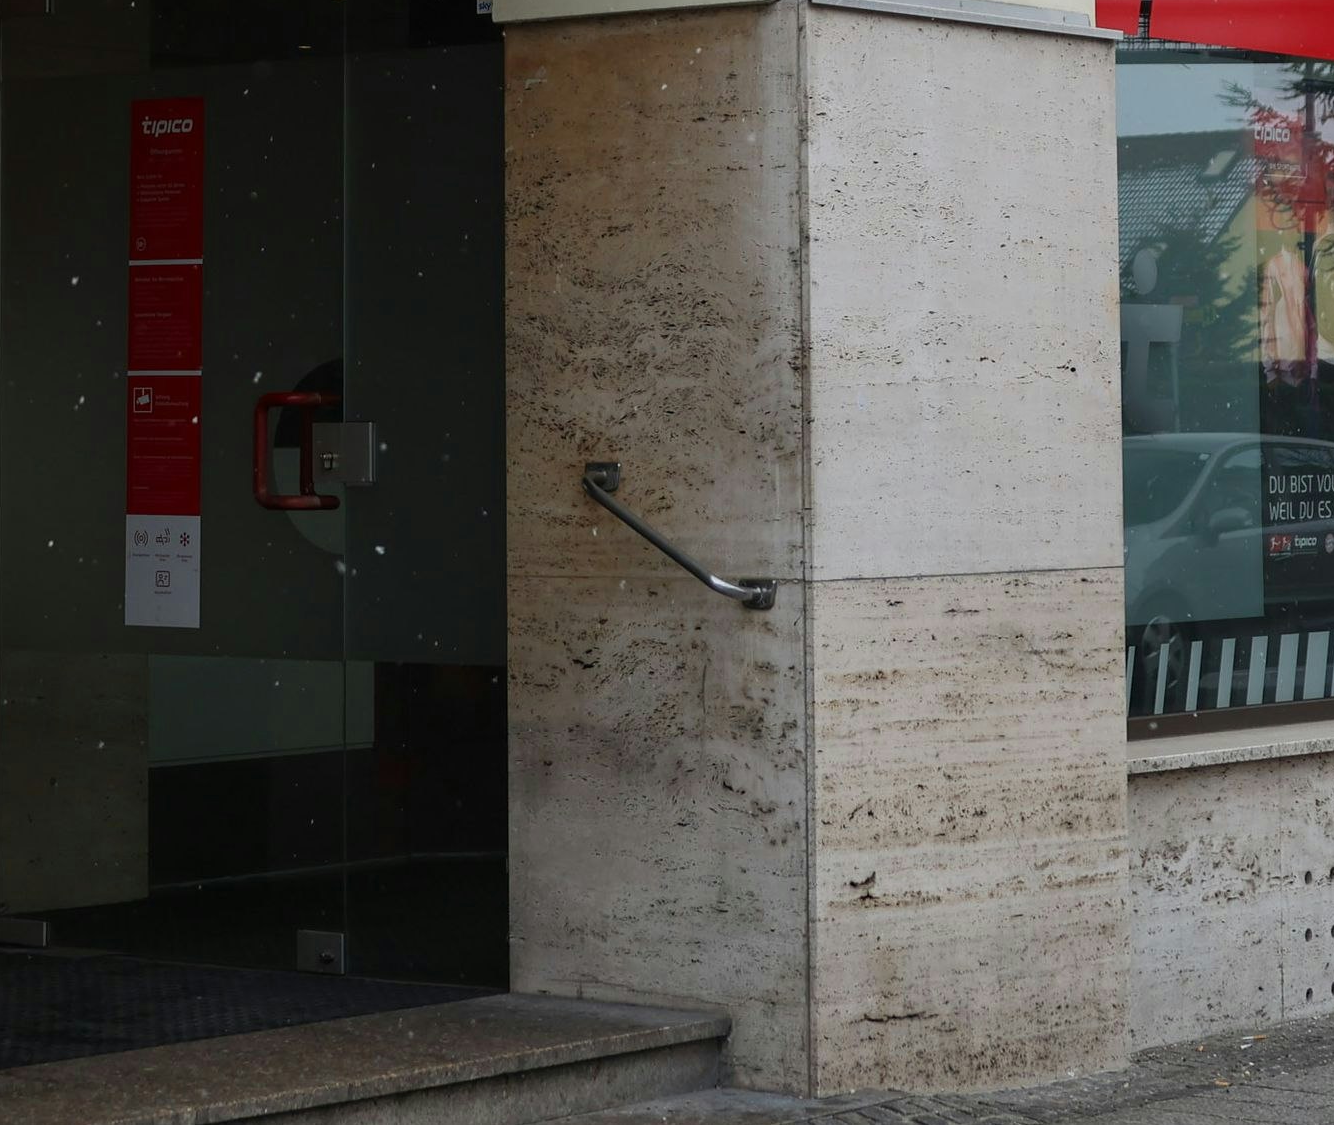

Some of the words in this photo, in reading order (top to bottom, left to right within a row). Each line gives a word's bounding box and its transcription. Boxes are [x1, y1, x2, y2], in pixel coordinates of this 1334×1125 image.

[141, 116, 193, 138] tipico
[1269, 475, 1286, 494] DU
[1290, 474, 1314, 494] BIST
[1269, 501, 1296, 521] WEIL
[1299, 501, 1314, 519] DU
[1318, 500, 1332, 519] ES
[1294, 535, 1317, 548] tipico
